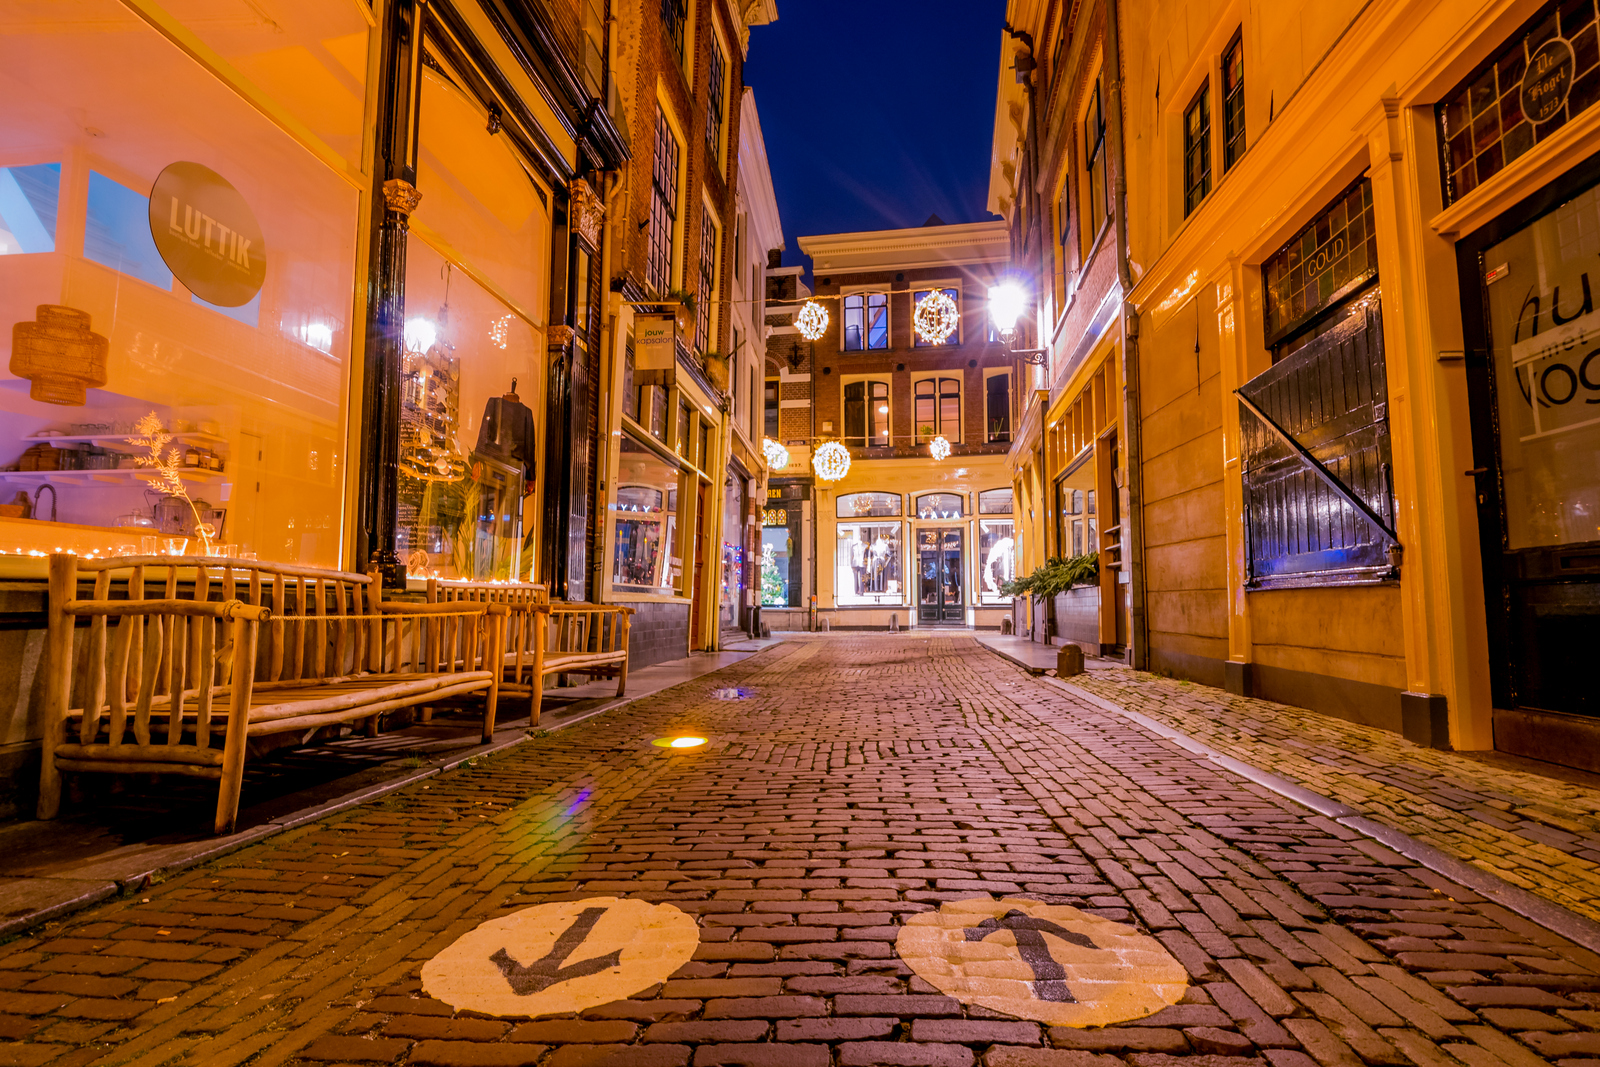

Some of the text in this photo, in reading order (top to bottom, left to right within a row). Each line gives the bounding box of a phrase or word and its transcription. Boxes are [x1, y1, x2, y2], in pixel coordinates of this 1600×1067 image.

[1535, 53, 1554, 75] De
[1528, 66, 1566, 101] Kogel
[1539, 97, 1559, 118] 1573
[169, 196, 252, 270] LUTTIK
[1514, 254, 1600, 344] hu
[636, 336, 674, 345] kapsalon
[645, 329, 665, 337] jouw
[1541, 327, 1588, 360] met
[919, 510, 960, 520] YAYA
